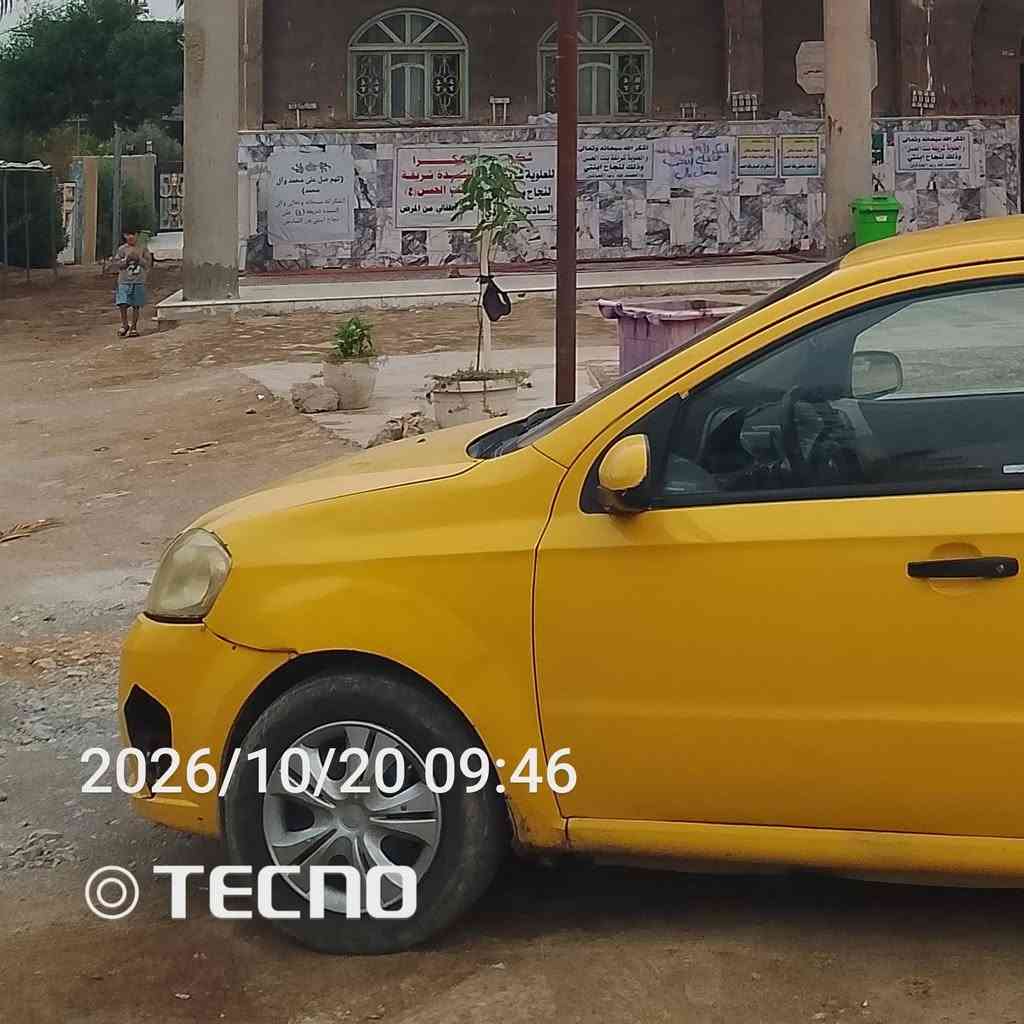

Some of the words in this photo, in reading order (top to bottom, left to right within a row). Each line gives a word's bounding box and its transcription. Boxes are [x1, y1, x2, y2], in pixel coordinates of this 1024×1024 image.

[578, 144, 599, 153] وتعالى
[526, 186, 552, 200] لنجاح
[527, 205, 554, 215] الساد
